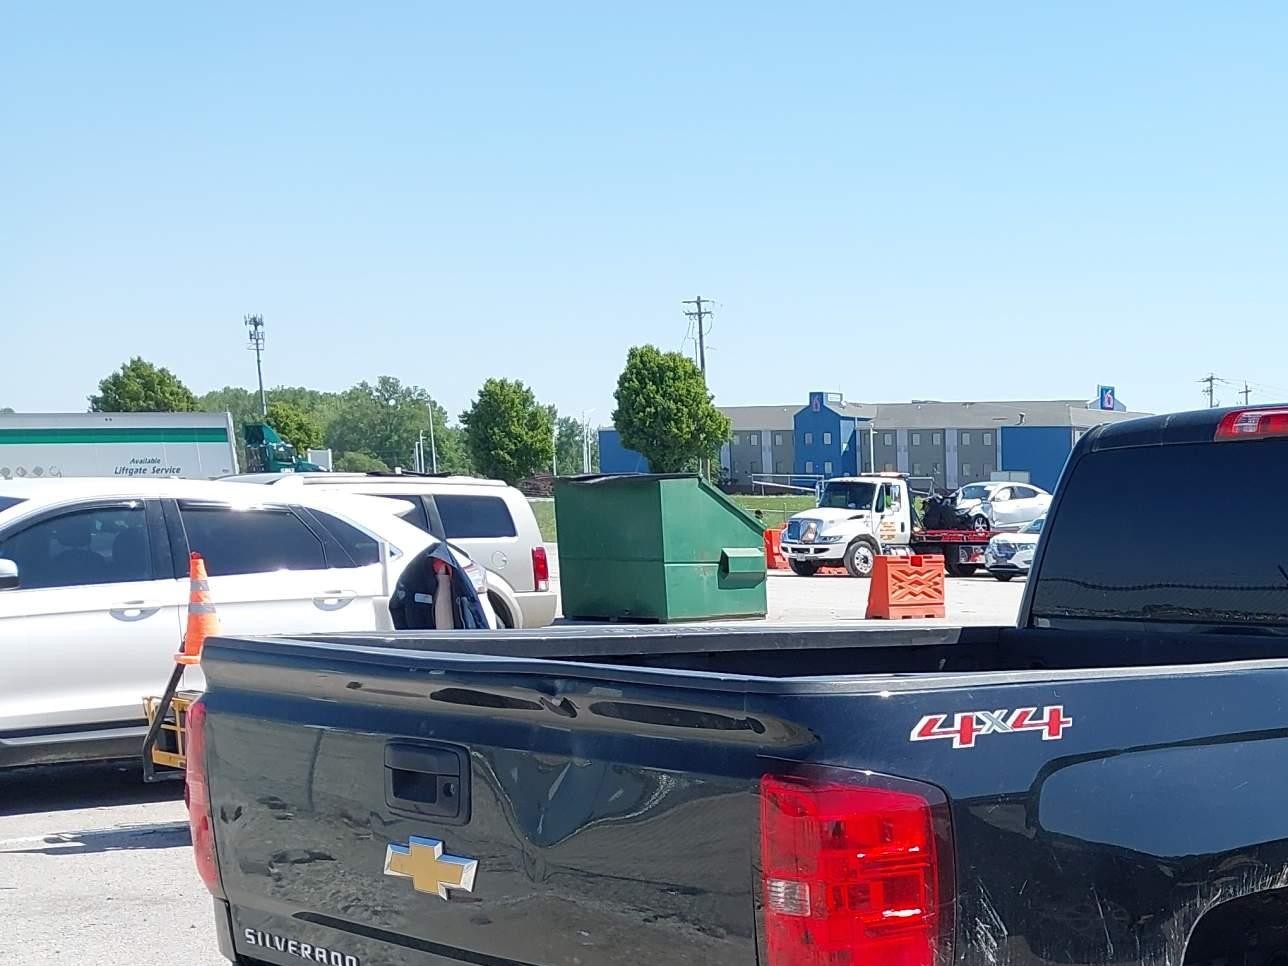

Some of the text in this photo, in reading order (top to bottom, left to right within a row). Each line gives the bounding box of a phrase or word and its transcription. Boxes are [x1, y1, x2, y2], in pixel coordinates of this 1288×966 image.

[129, 457, 161, 465] Available
[114, 465, 182, 476] Liftgate Service
